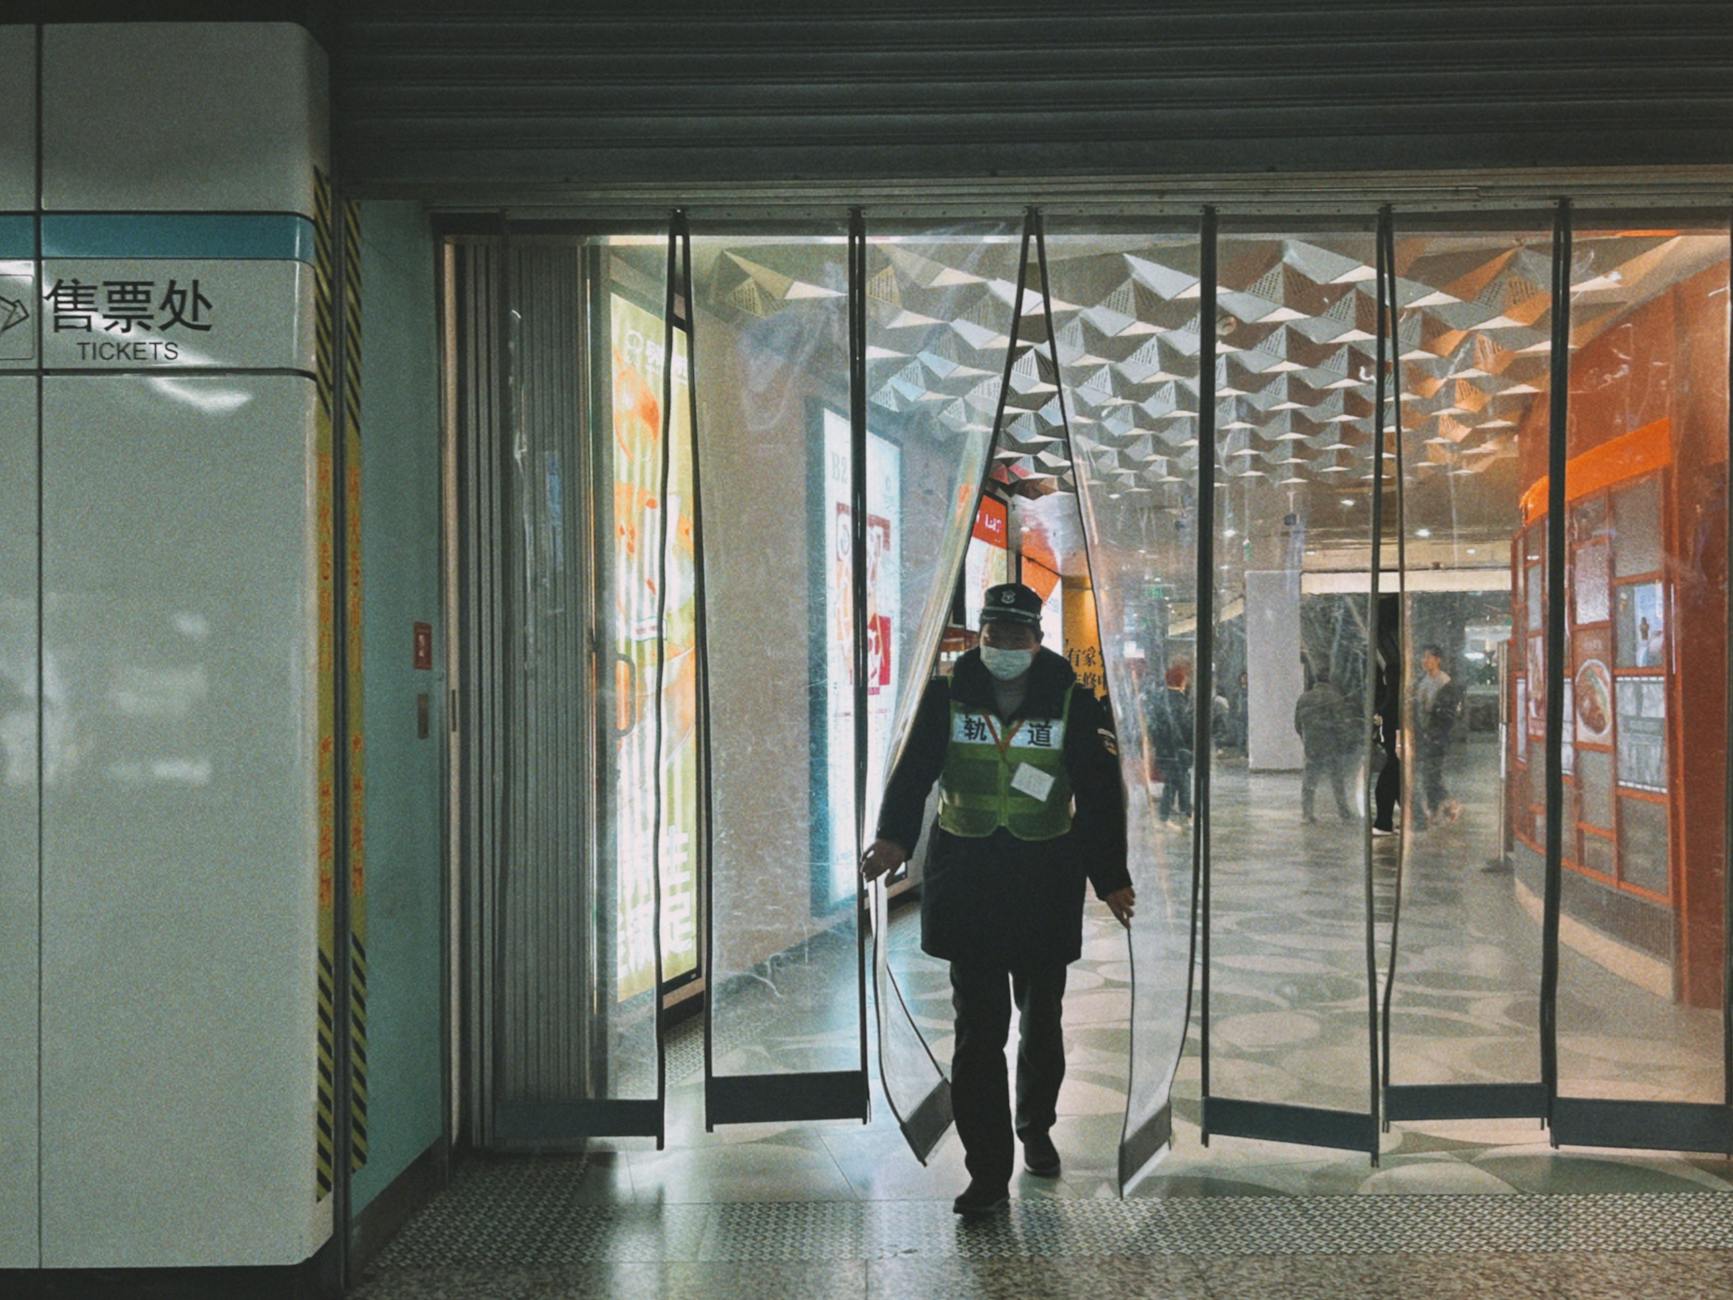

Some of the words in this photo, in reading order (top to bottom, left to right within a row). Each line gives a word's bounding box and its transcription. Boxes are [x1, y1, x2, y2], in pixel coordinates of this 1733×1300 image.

[44, 278, 213, 333] 售票处
[77, 342, 179, 361] TICKETS
